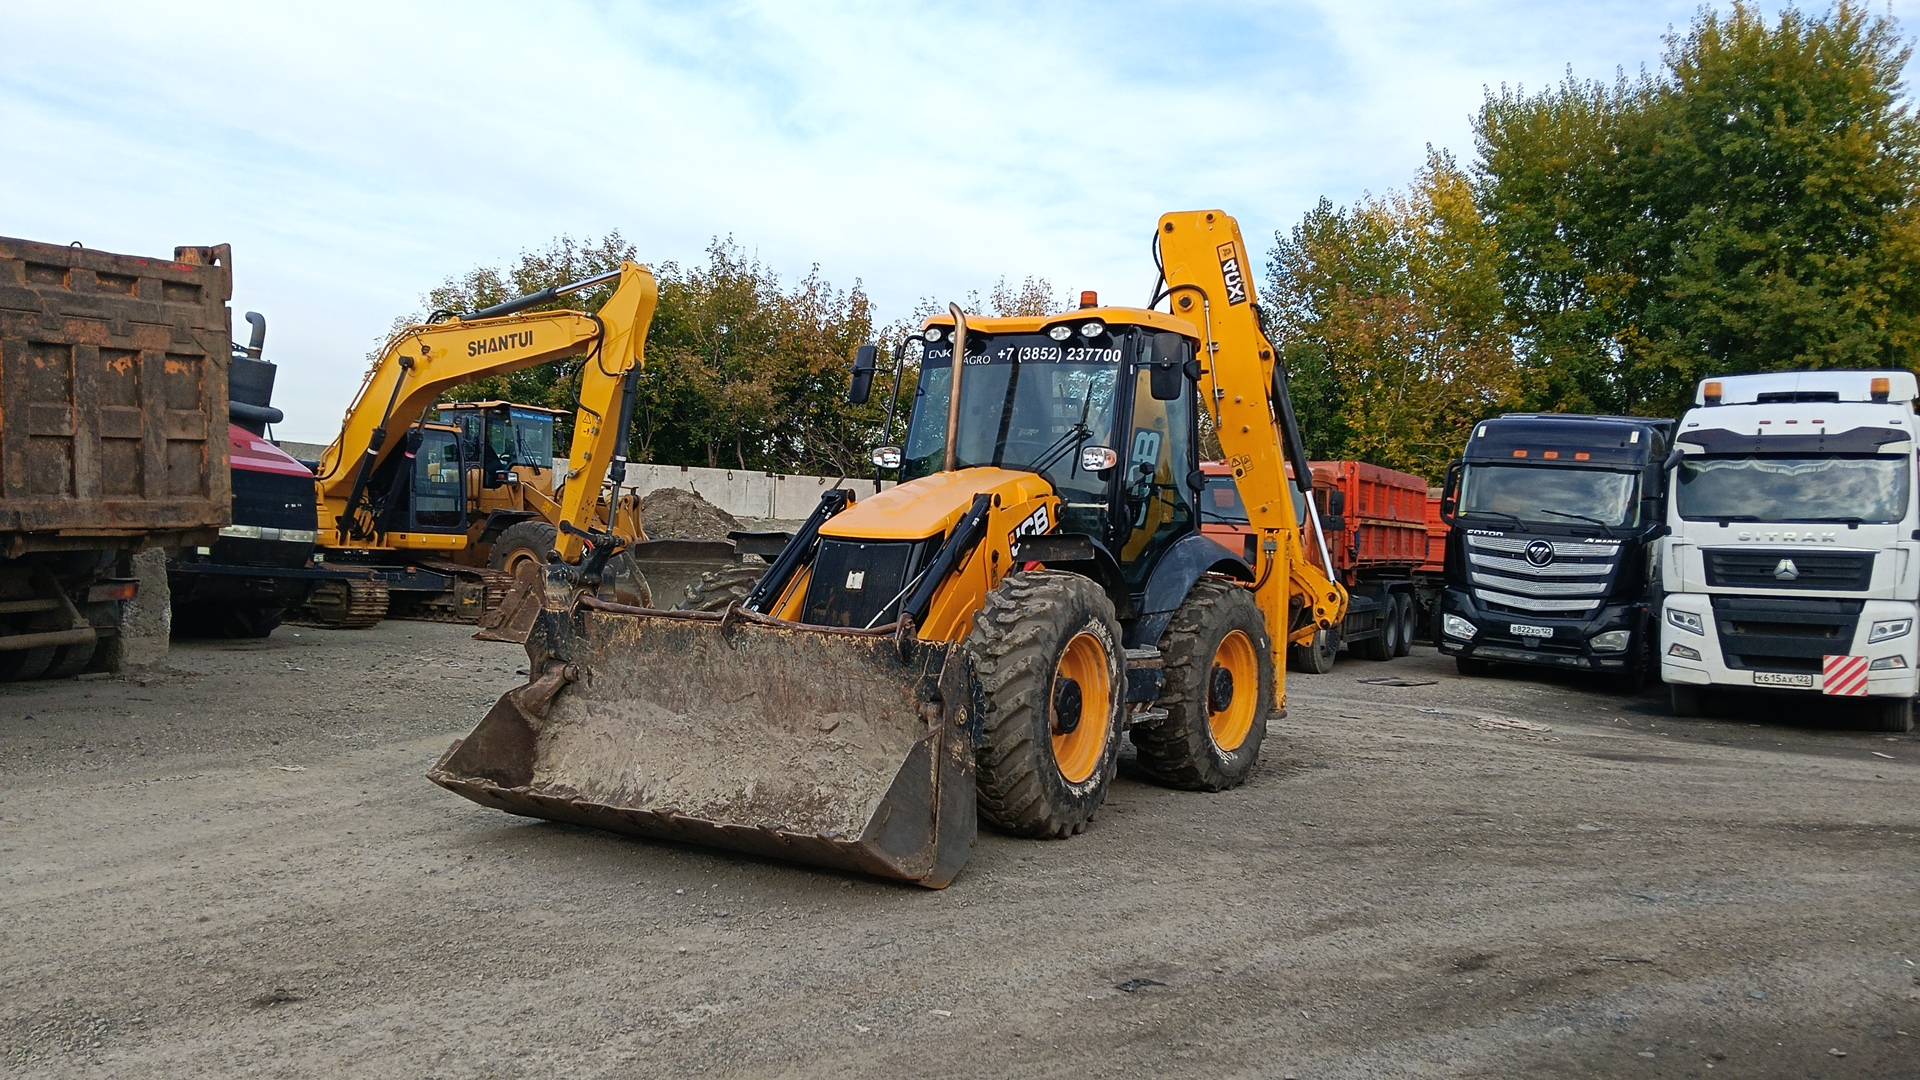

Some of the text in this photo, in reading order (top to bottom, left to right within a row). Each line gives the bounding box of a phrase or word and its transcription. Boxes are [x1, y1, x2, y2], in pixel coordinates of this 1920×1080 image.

[467, 330, 533, 357] SHANTUI
[963, 355, 991, 365] AGRO
[997, 347, 1122, 363] +7 (3852) 237700
[1011, 506, 1049, 557] JCB
[1737, 531, 1836, 543] SITRAK
